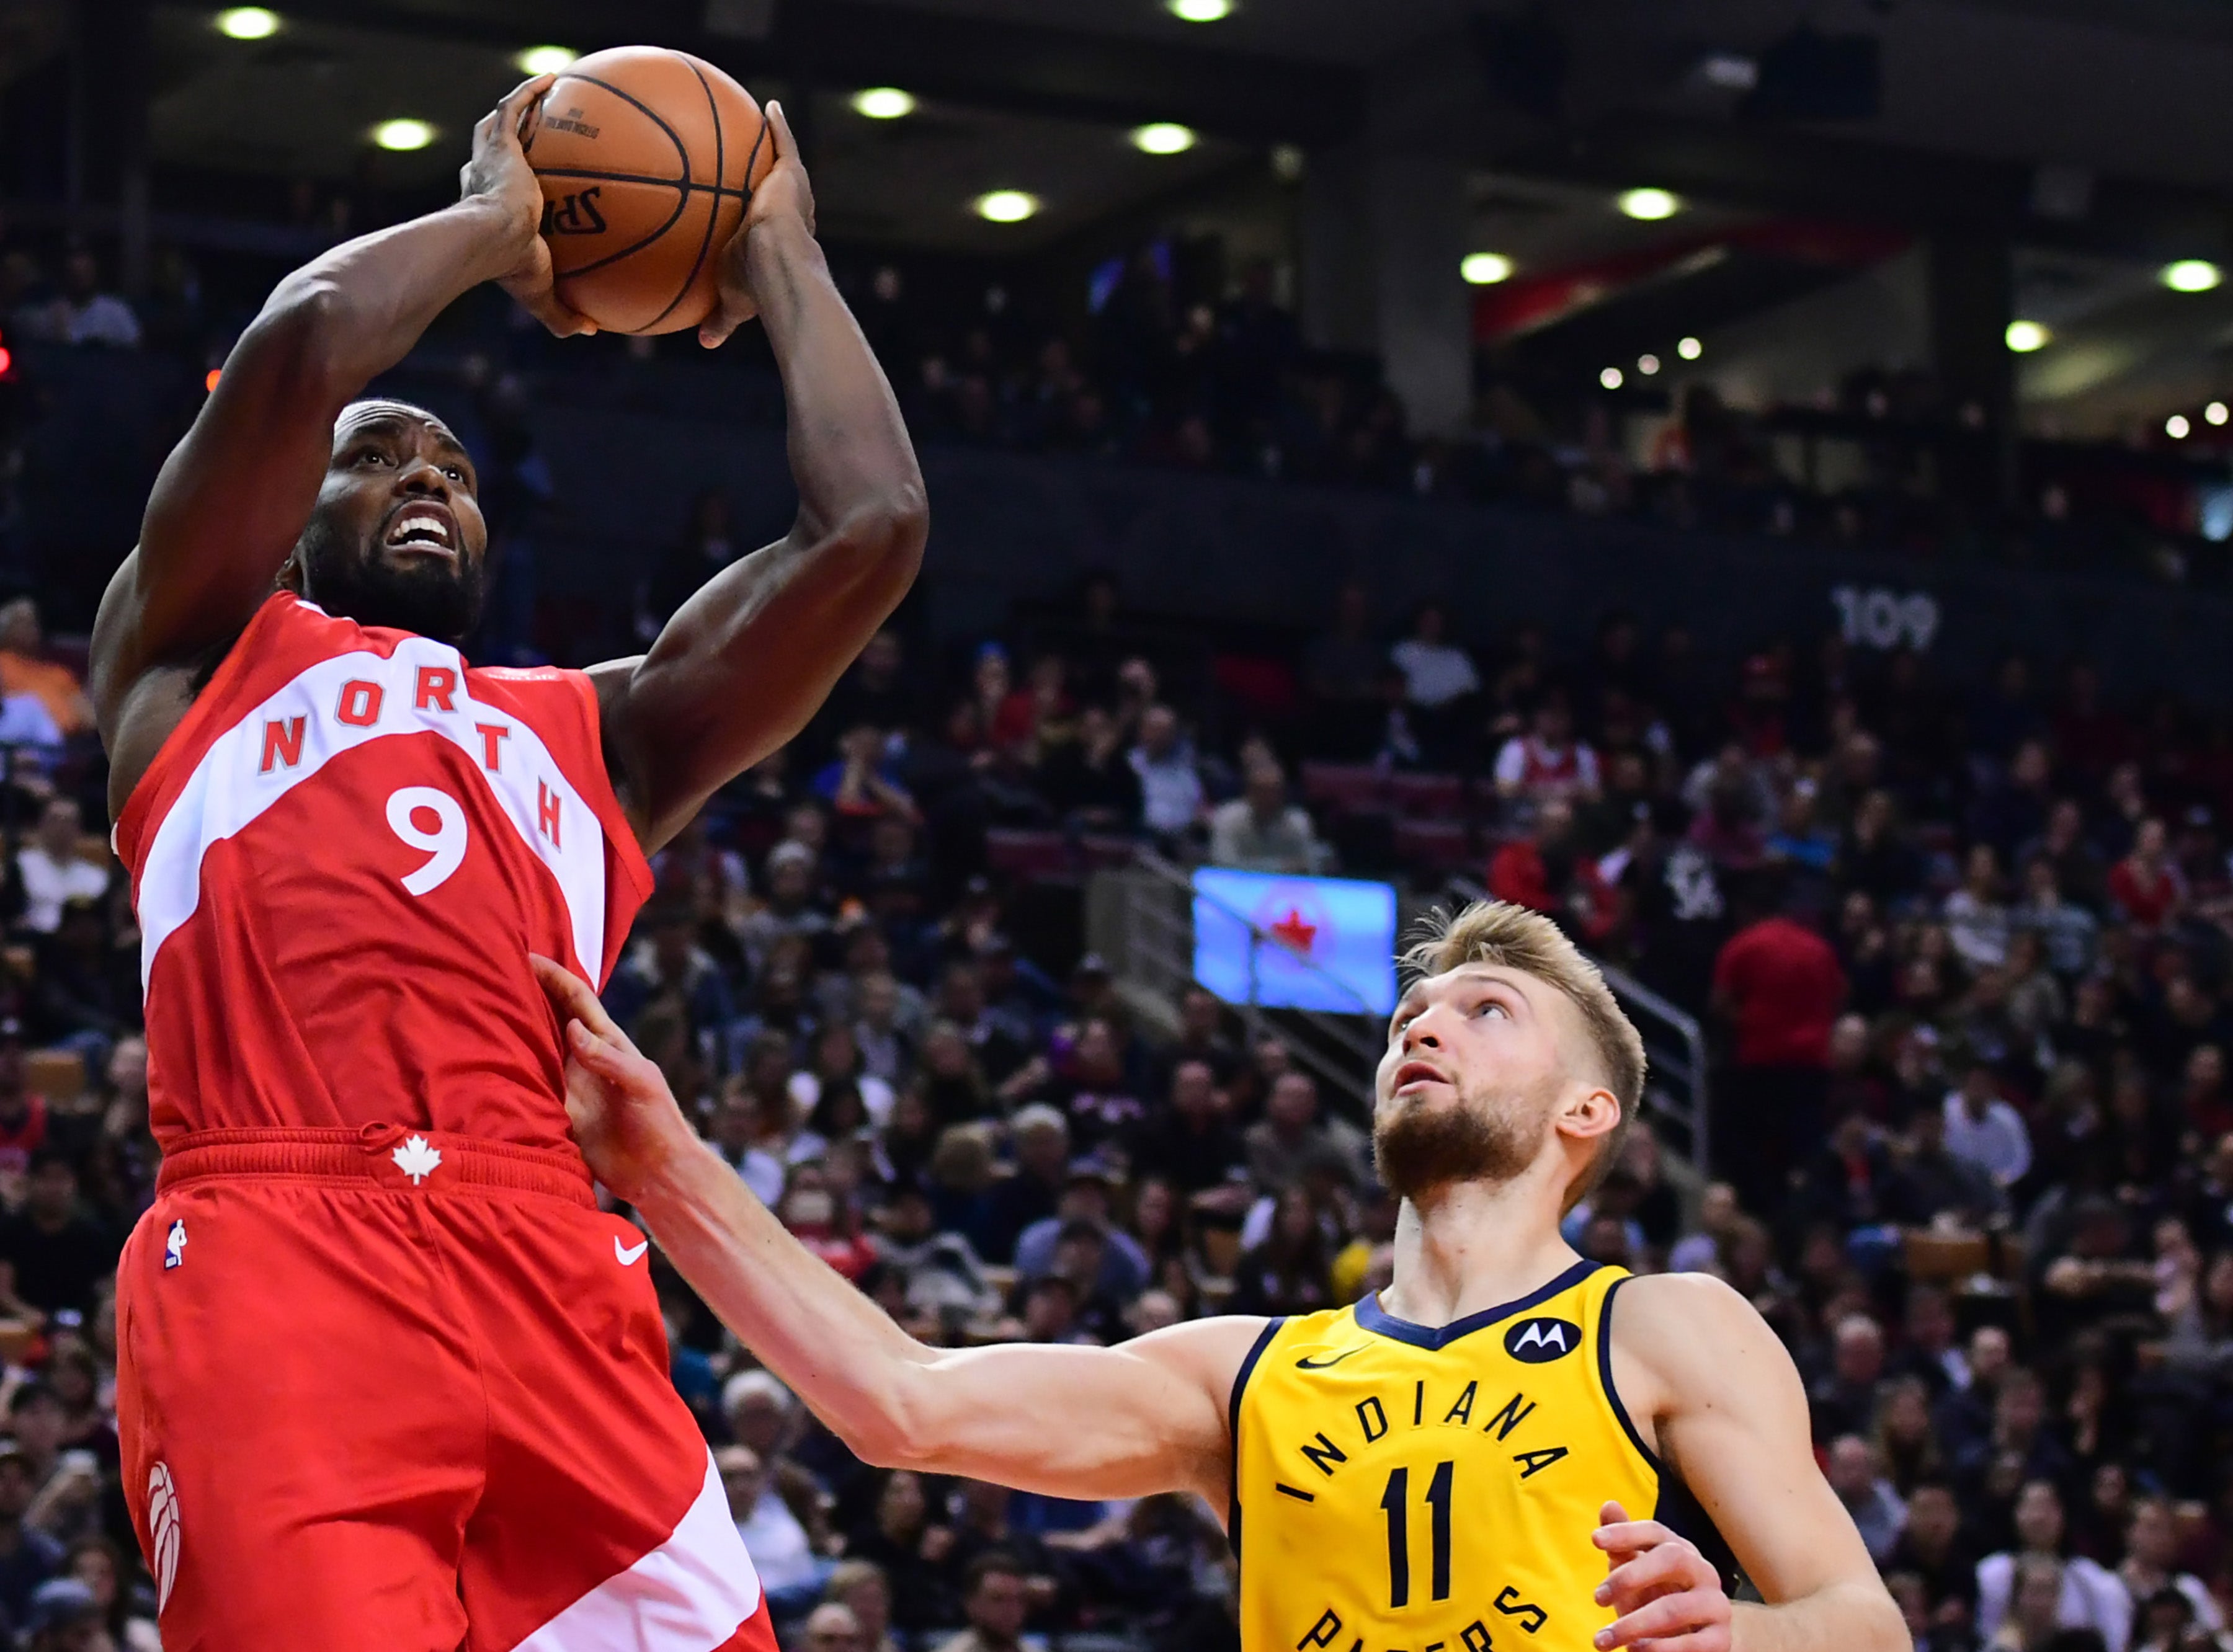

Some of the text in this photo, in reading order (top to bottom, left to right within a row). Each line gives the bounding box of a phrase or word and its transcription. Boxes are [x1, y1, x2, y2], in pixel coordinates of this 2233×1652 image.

[1830, 587, 1937, 651] 109
[258, 665, 563, 853] NORTH
[386, 786, 468, 896] 9
[1276, 1380, 1568, 1503] INDIANA
[1380, 1460, 1453, 1608] 11
